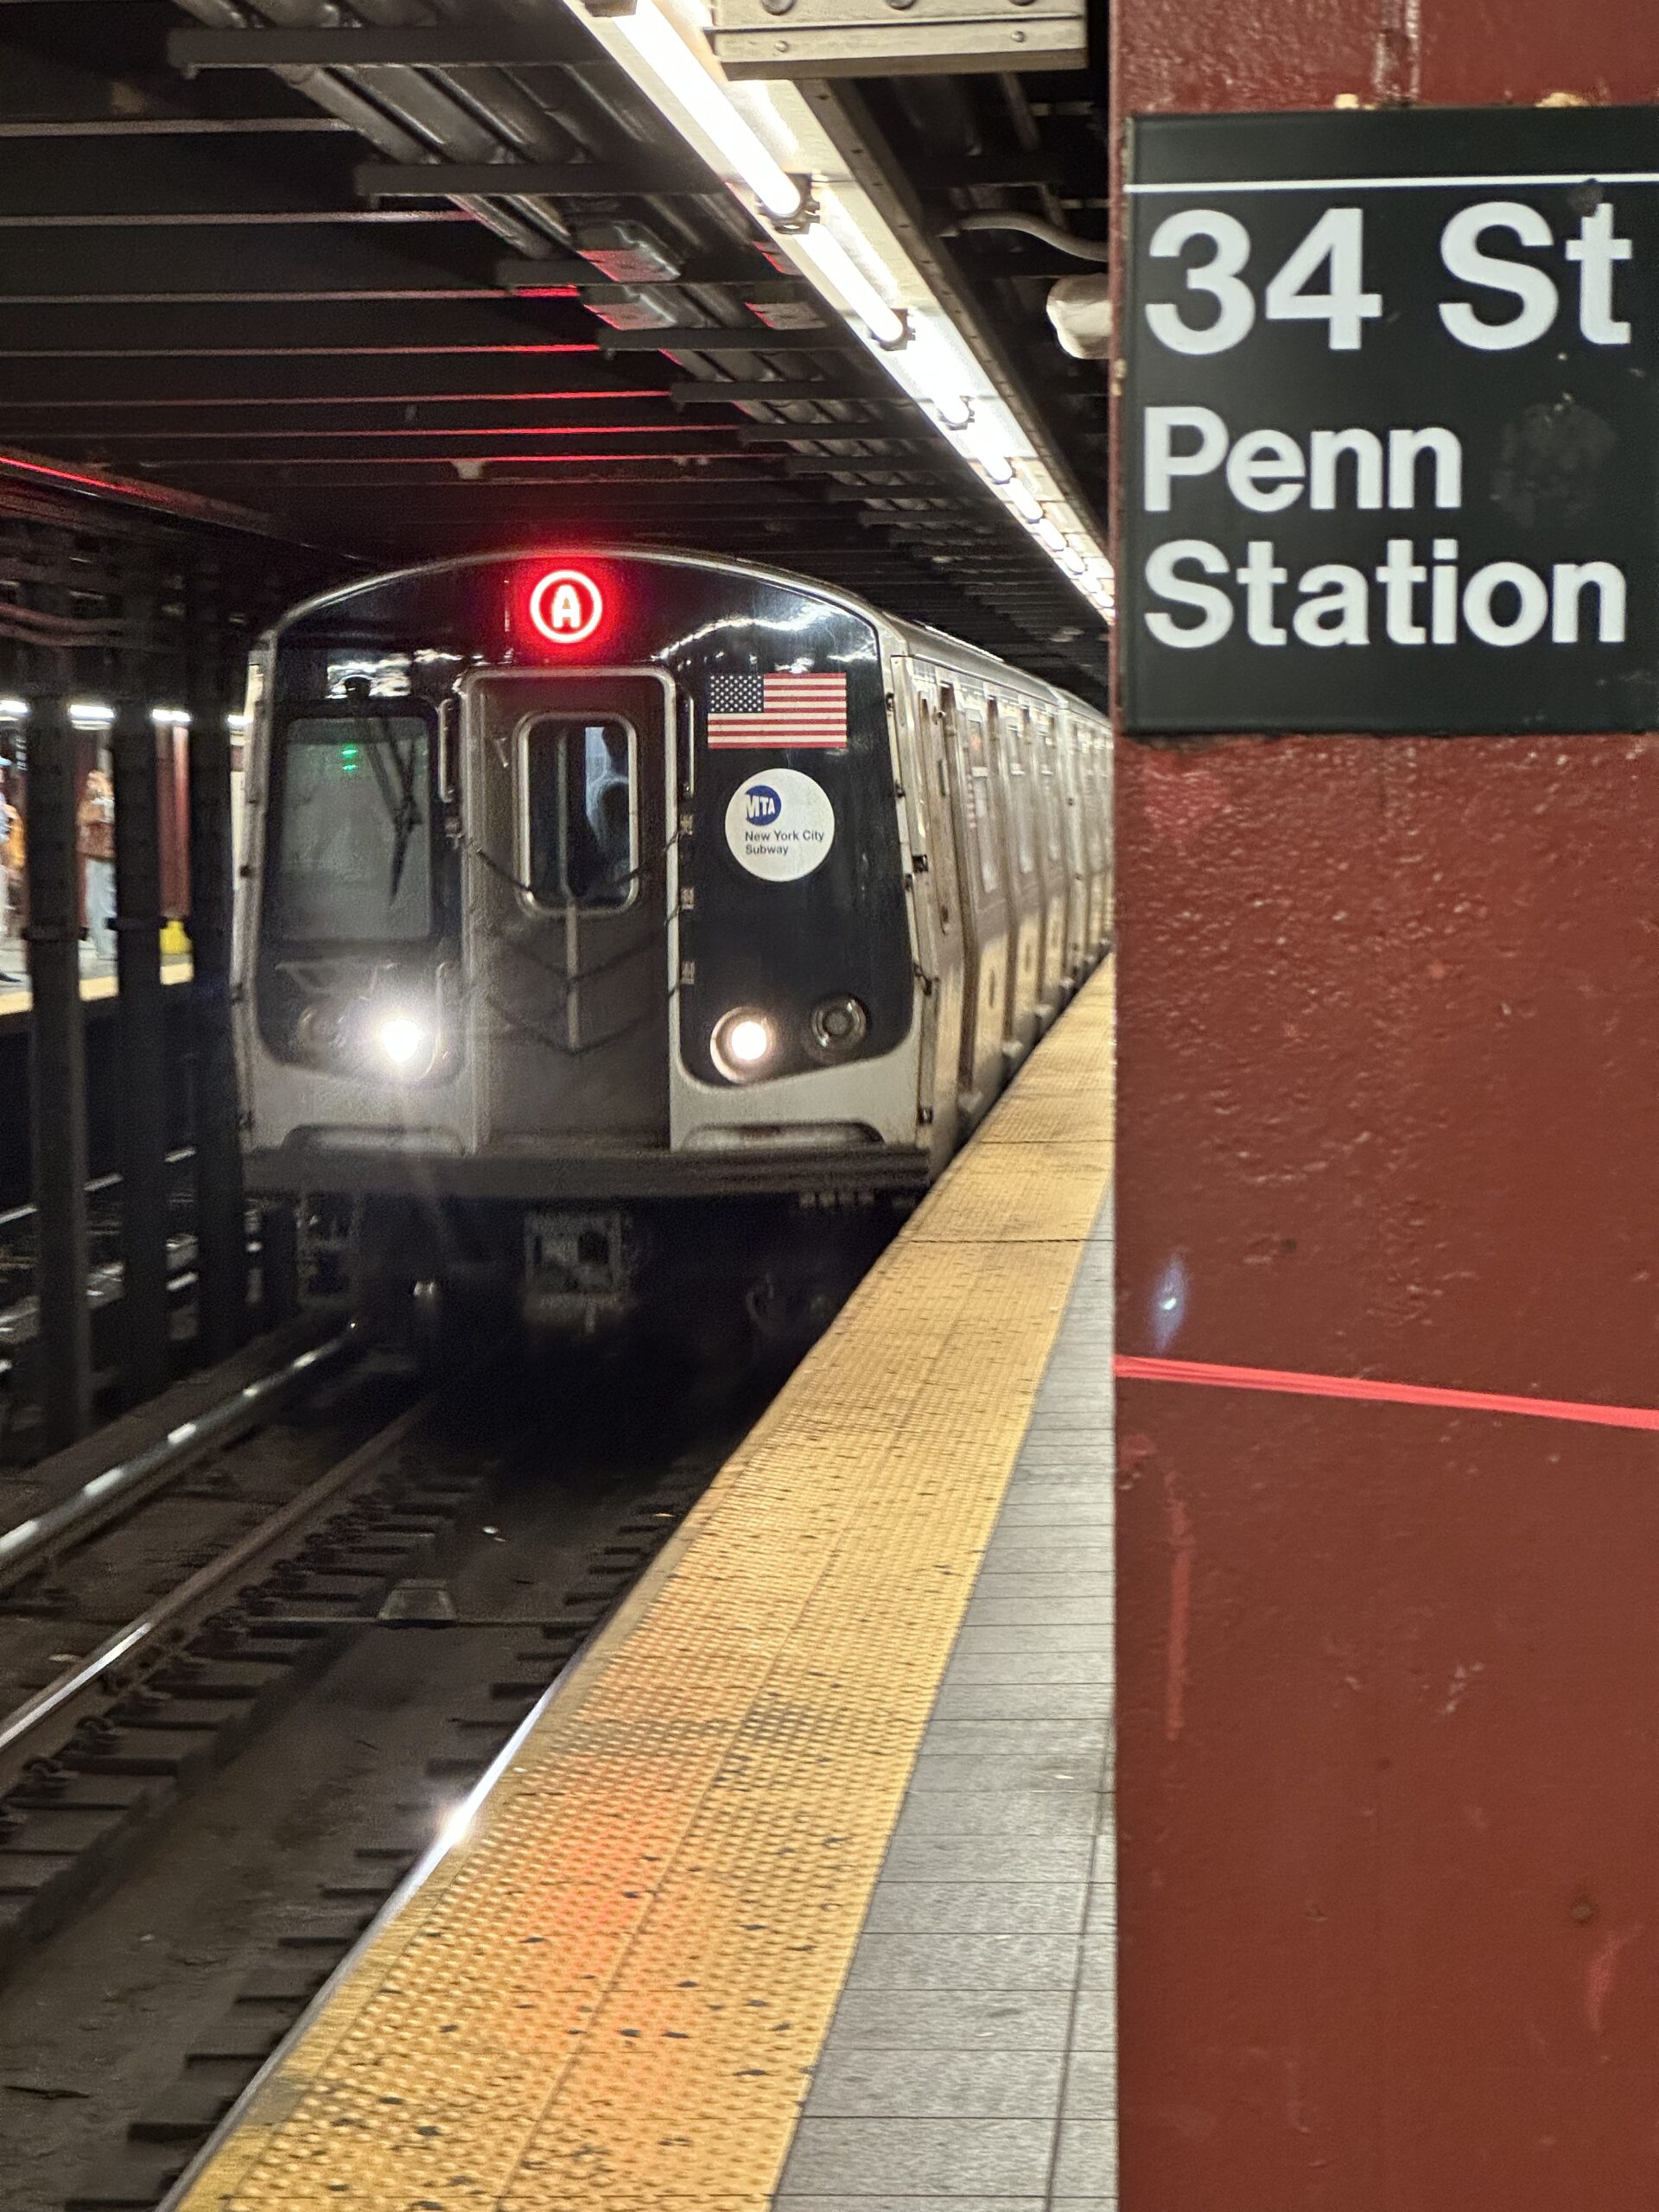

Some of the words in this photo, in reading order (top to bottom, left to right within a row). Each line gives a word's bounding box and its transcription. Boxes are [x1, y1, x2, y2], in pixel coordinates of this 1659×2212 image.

[1145, 207, 1383, 355] 34
[1438, 201, 1634, 351] St
[1143, 406, 1464, 512] Penn
[551, 584, 582, 629] A
[1144, 538, 1628, 649] Station
[745, 794, 776, 819] MTA
[745, 830, 770, 842] New
[774, 830, 799, 842] York
[802, 830, 824, 842] City
[746, 844, 788, 855] Subway
